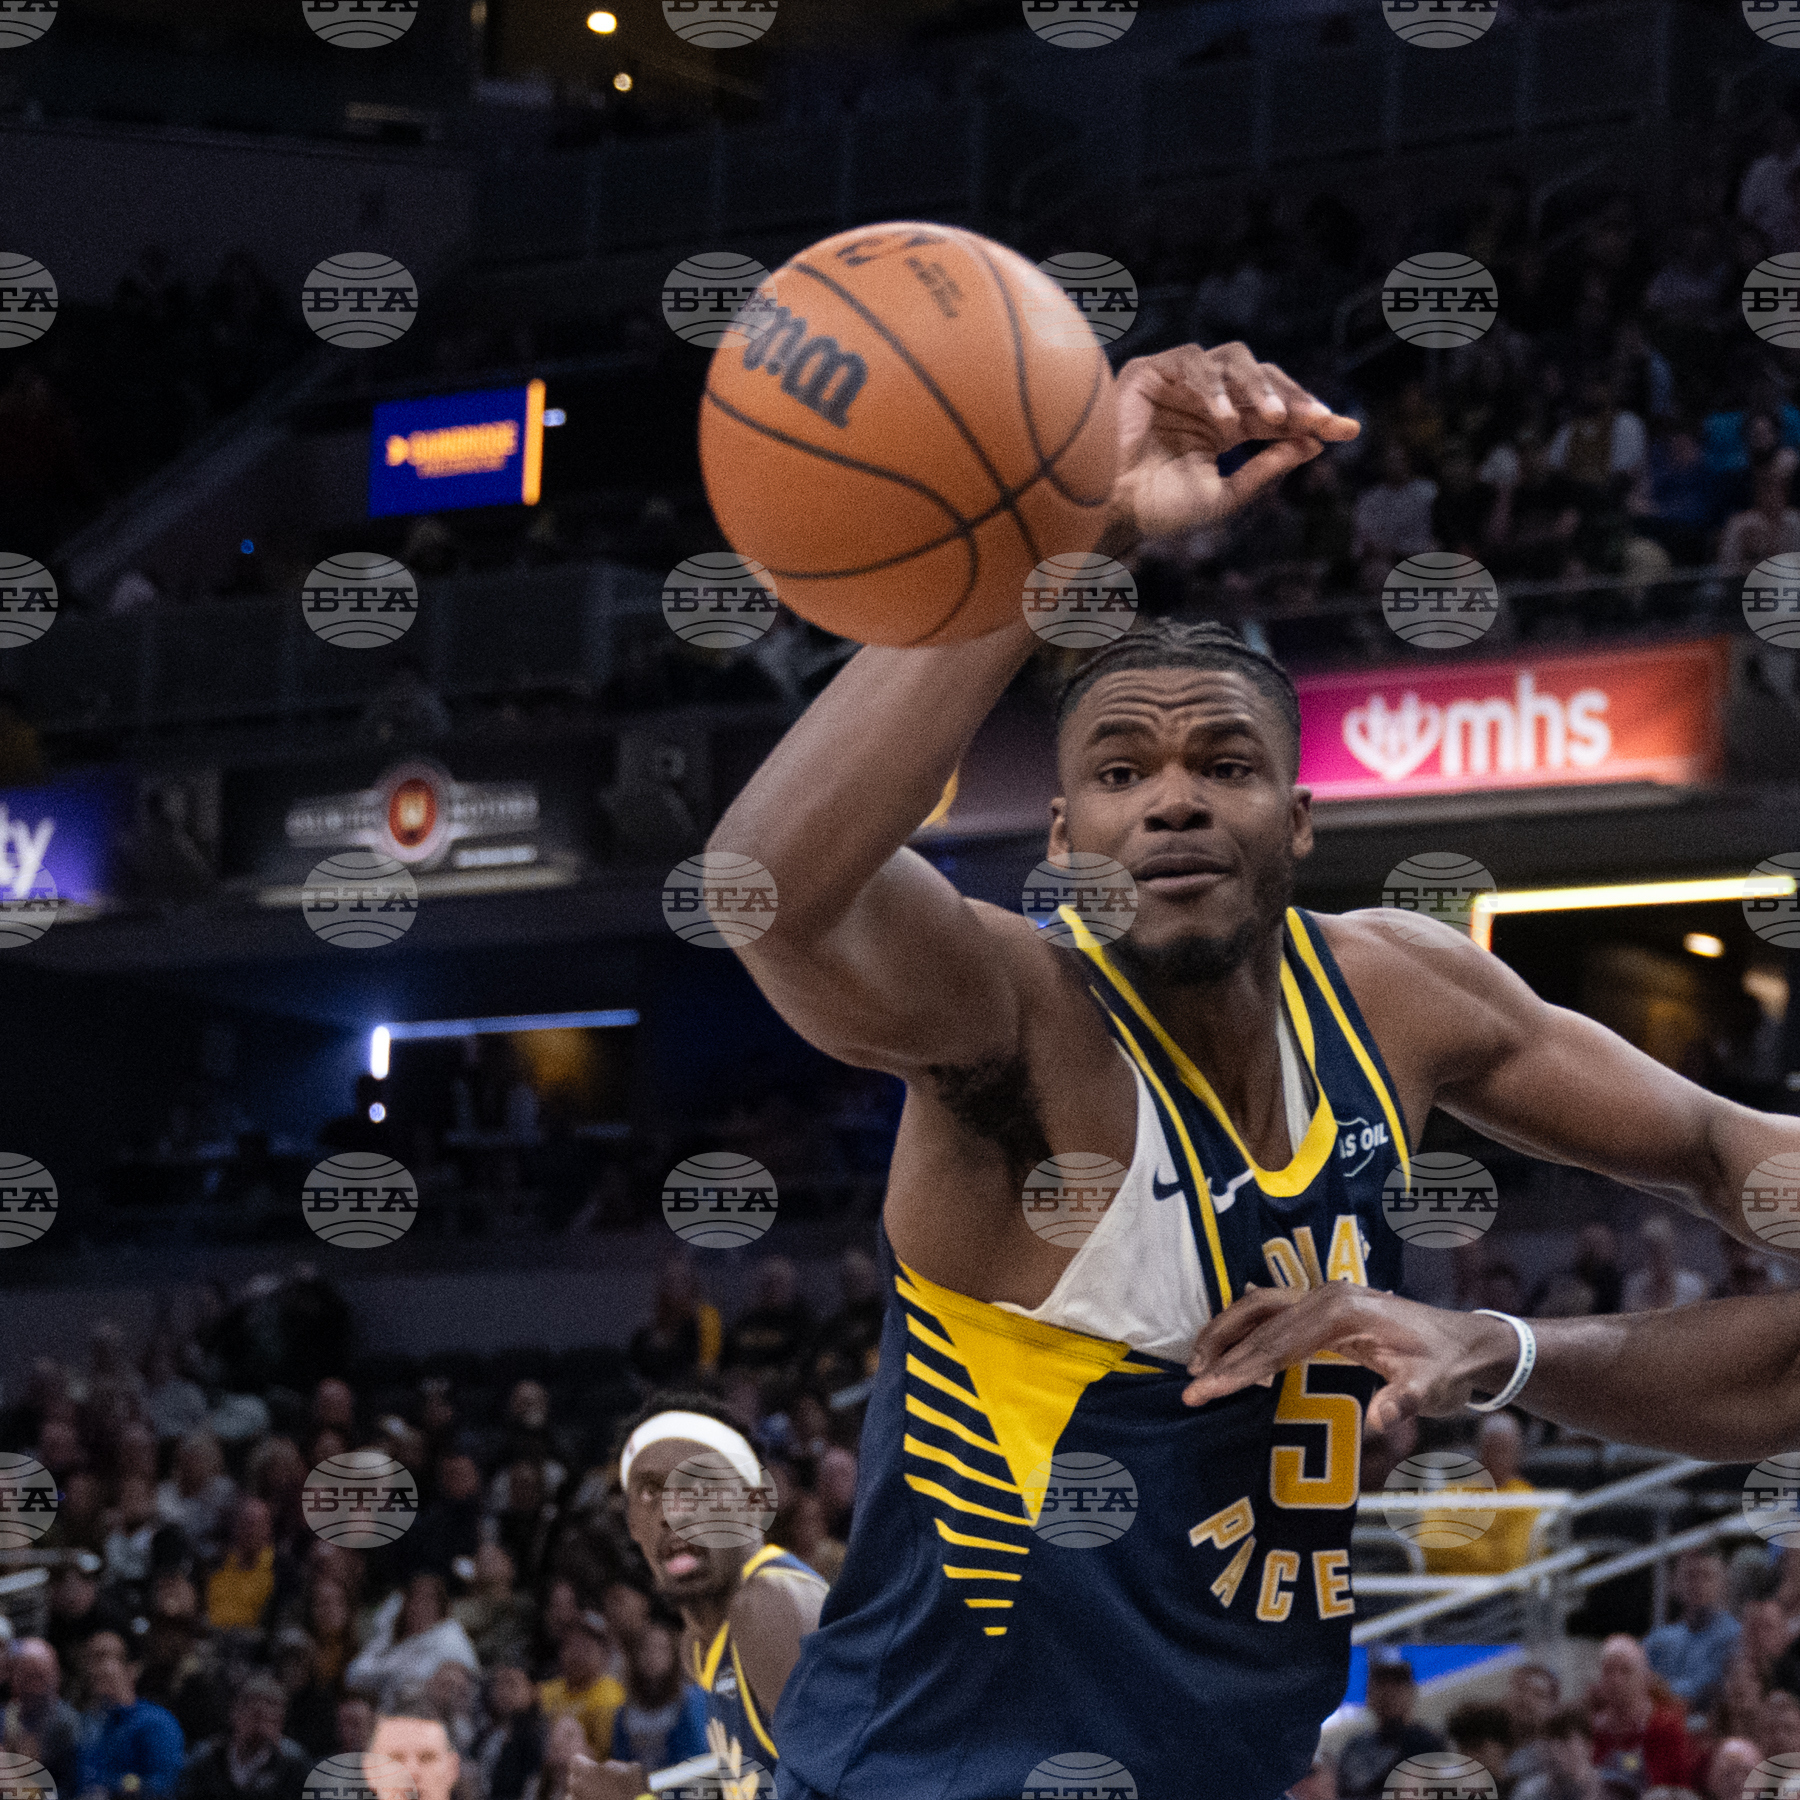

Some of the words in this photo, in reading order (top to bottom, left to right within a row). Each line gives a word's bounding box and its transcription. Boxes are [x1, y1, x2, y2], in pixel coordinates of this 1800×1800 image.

[1441, 667, 1612, 778] mhs
[1360, 1122, 1389, 1152] OIL
[1269, 1351, 1364, 1511] 5
